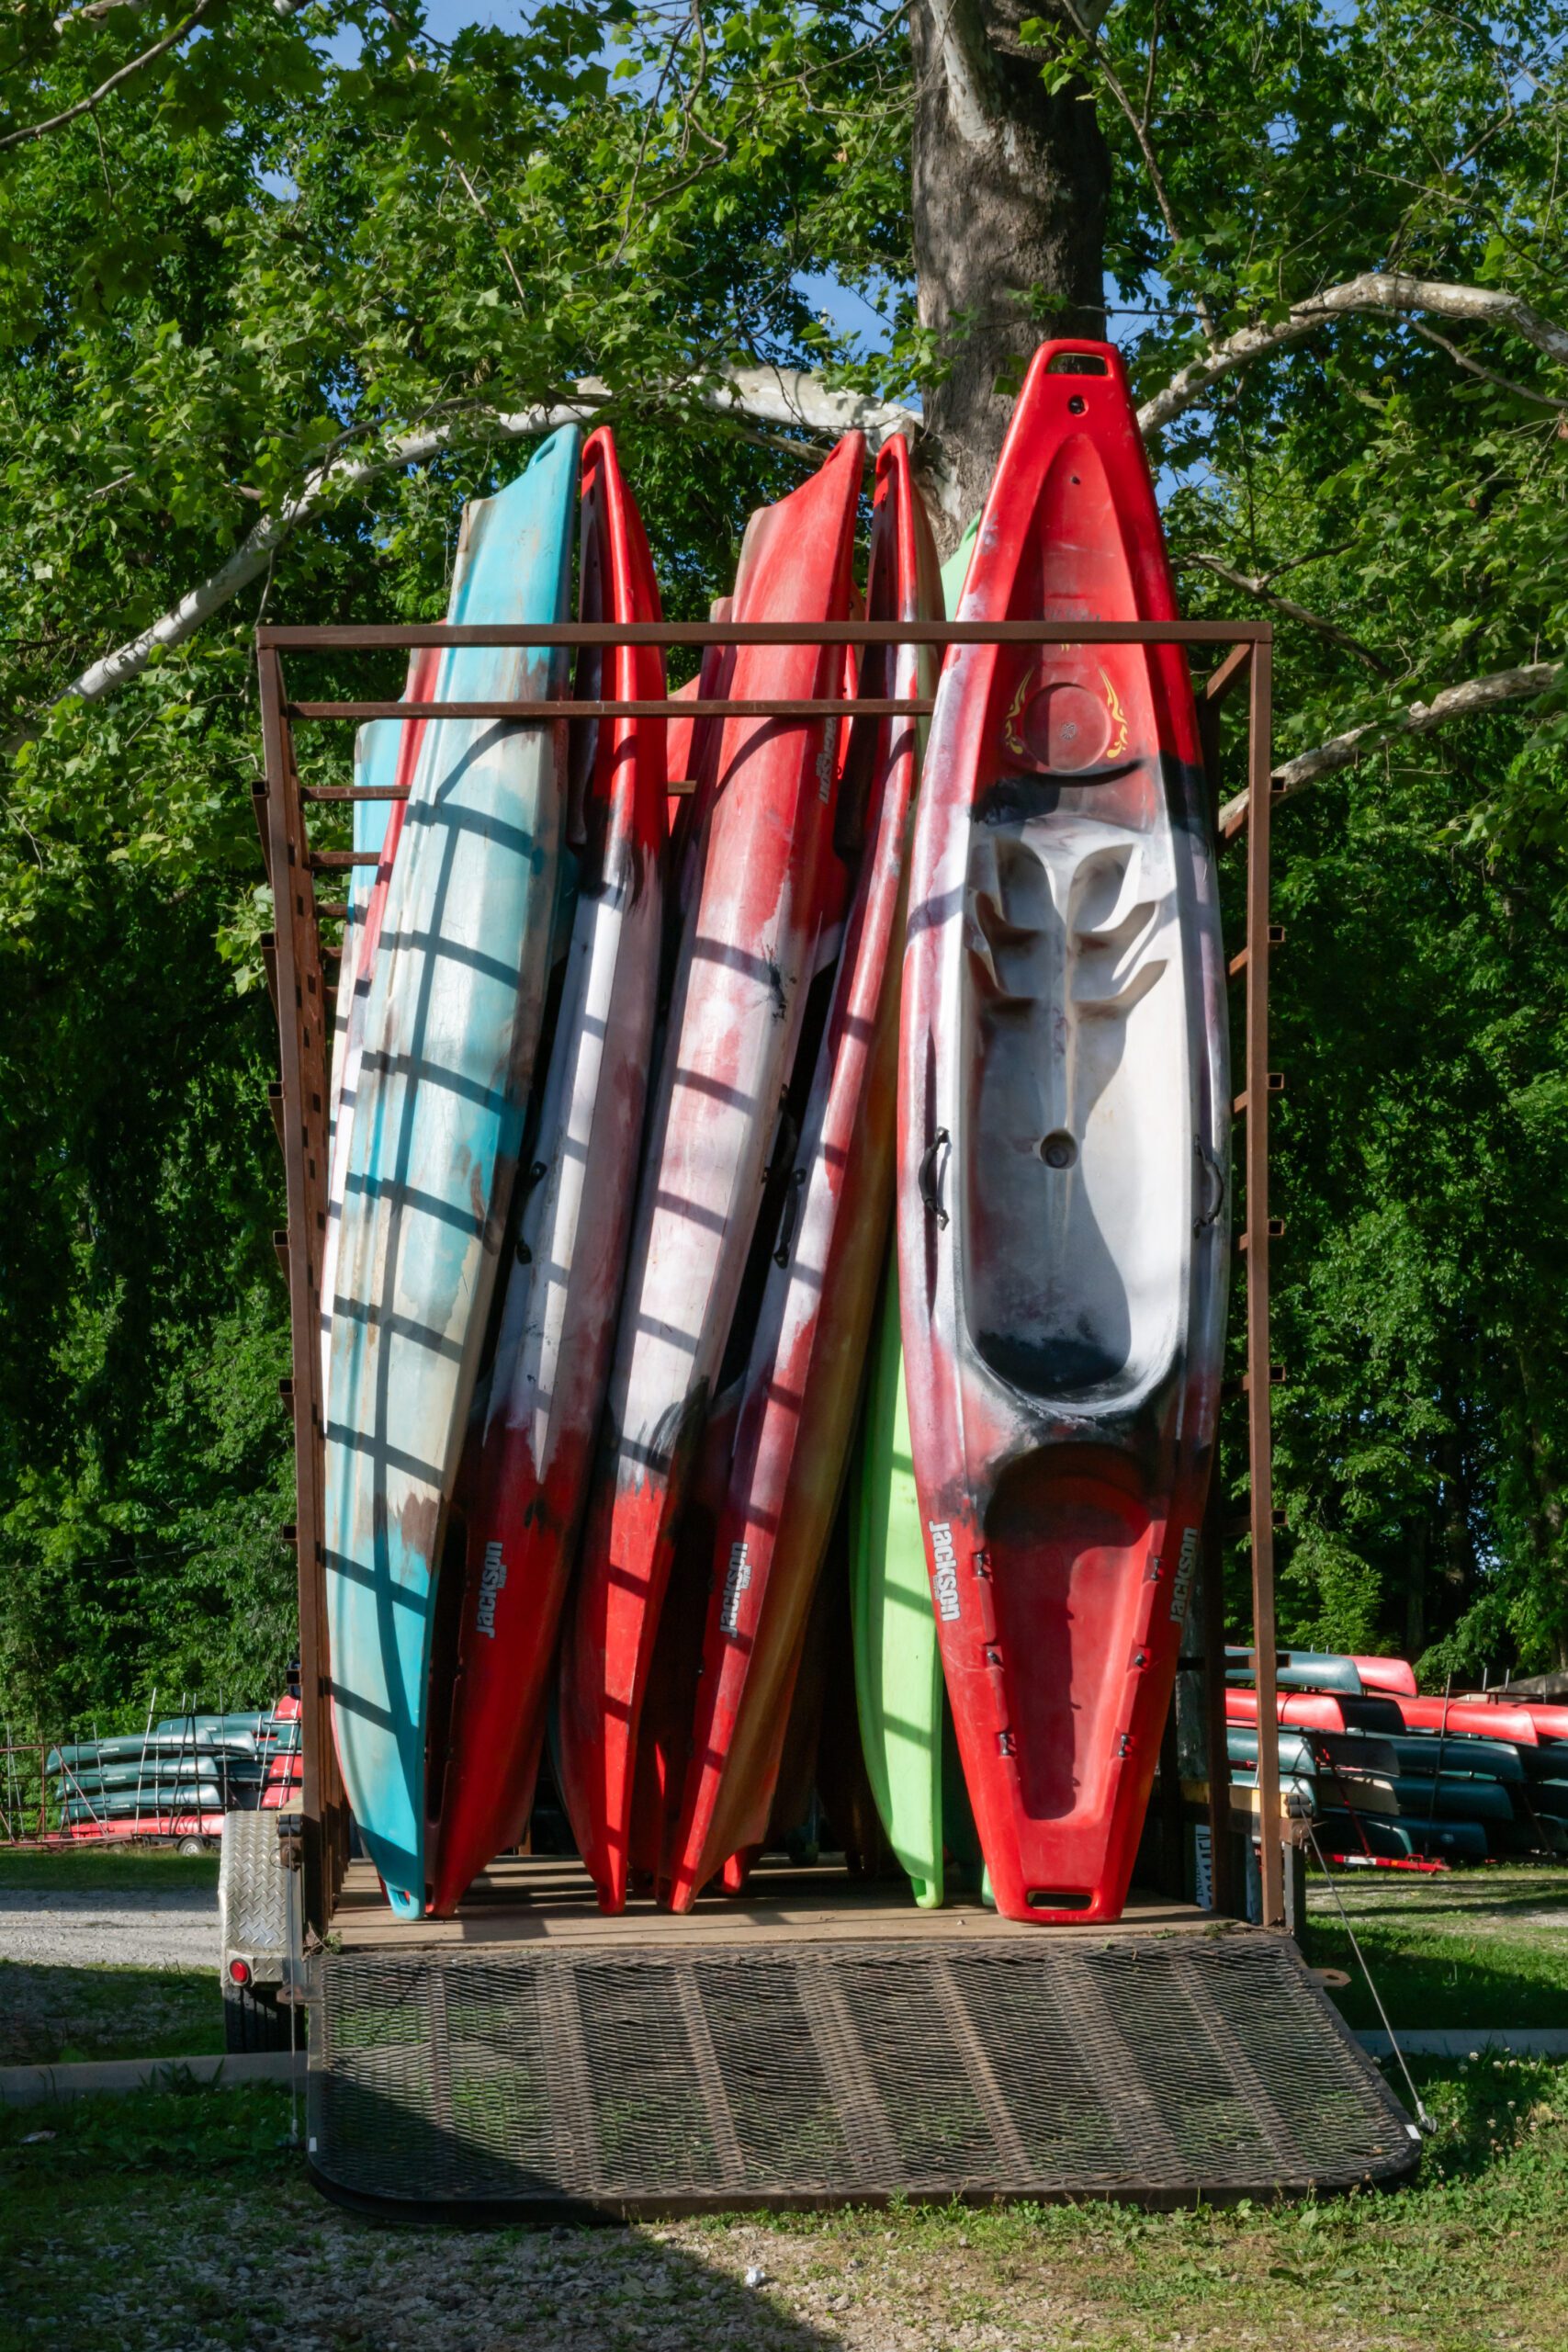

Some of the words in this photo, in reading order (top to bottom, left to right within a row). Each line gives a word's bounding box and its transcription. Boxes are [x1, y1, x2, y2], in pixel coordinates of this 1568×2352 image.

[818, 716, 838, 805] ackson
[476, 1541, 503, 1638] Jackson
[719, 1542, 749, 1638] Jackson
[929, 1521, 961, 1622] Jackson
